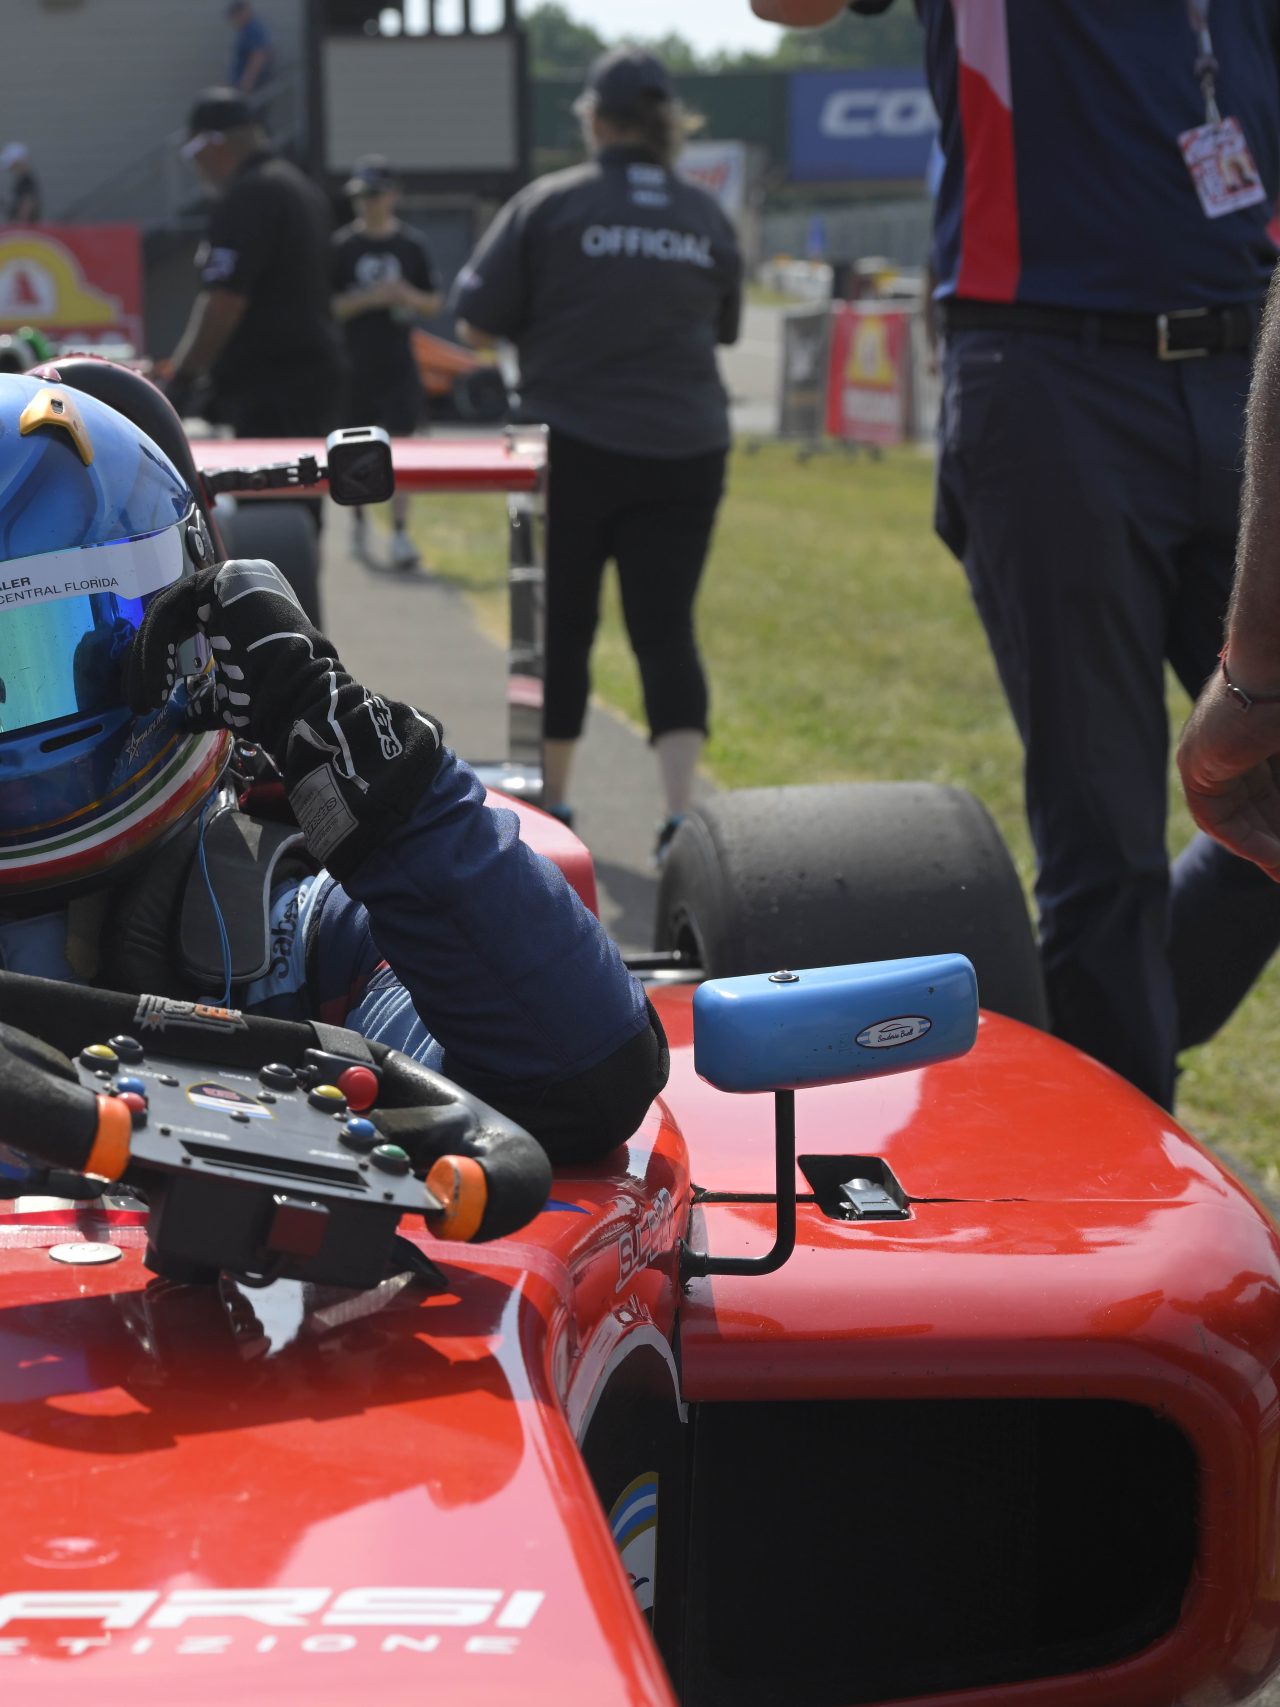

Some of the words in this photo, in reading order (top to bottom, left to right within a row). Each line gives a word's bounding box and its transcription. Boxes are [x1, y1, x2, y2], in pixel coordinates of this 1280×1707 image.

[821, 88, 941, 135] CO
[581, 225, 715, 268] OFFICIAL
[64, 577, 119, 593] FLORIDA
